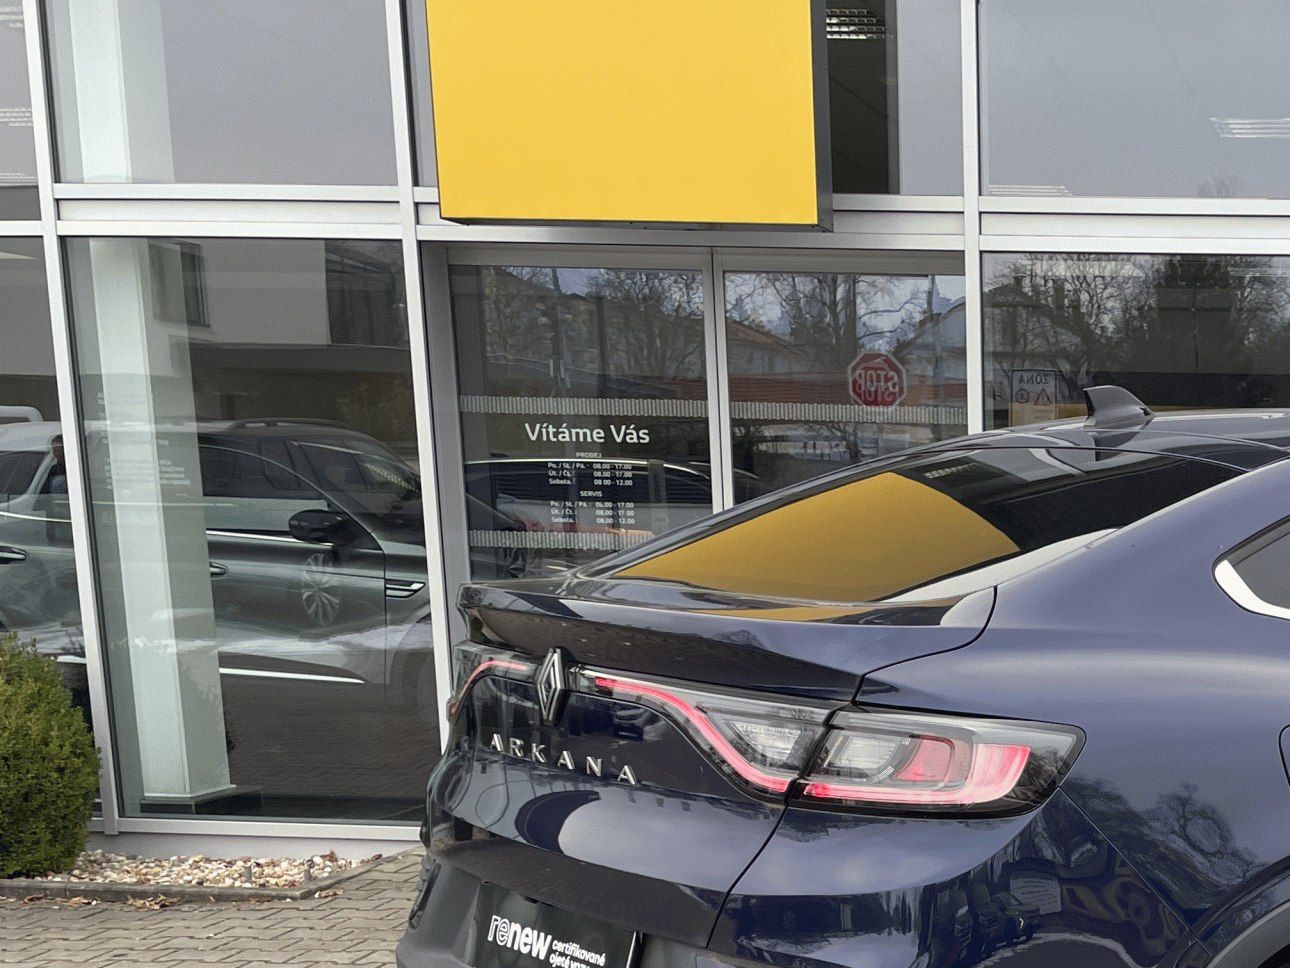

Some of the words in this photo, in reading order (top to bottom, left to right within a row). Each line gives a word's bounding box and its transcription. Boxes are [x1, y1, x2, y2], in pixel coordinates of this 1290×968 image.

[524, 422, 605, 443] Vítáme
[609, 424, 650, 444] Vás
[490, 733, 638, 786] ARKANA
[487, 914, 552, 960] renew
[549, 952, 571, 968] ojeté
[552, 940, 606, 967] certifikované
